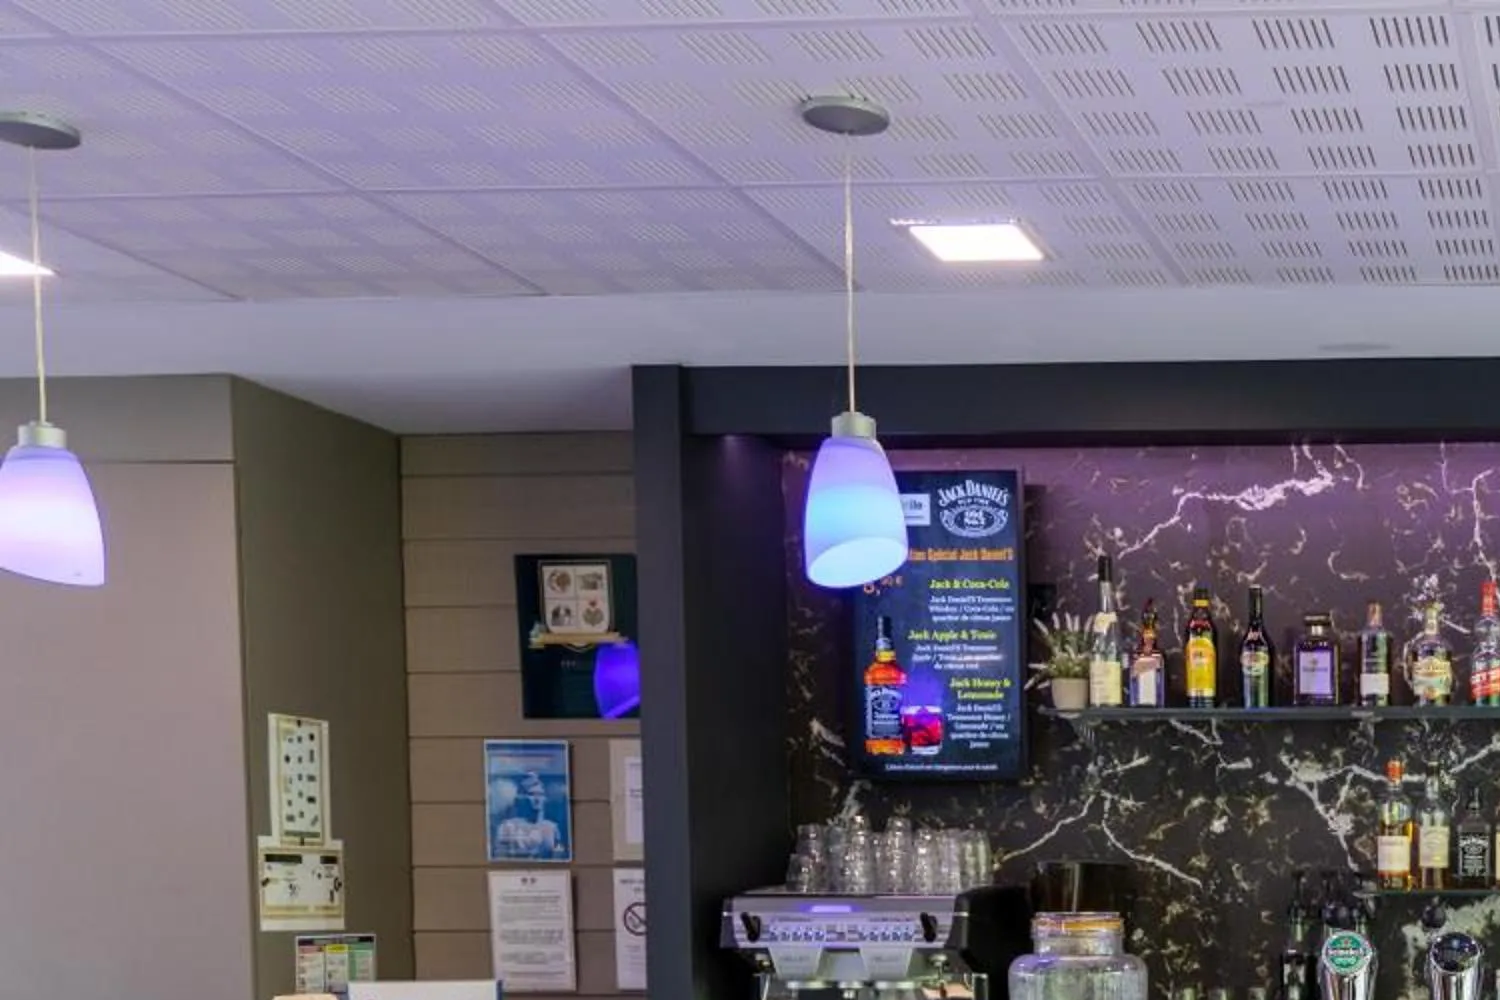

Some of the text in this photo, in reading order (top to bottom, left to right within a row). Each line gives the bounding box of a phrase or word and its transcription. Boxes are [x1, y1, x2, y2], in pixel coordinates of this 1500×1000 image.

[930, 579, 951, 589] Jack
[908, 630, 929, 641] Jack
[932, 630, 958, 643] Apple
[950, 678, 970, 689] Jack
